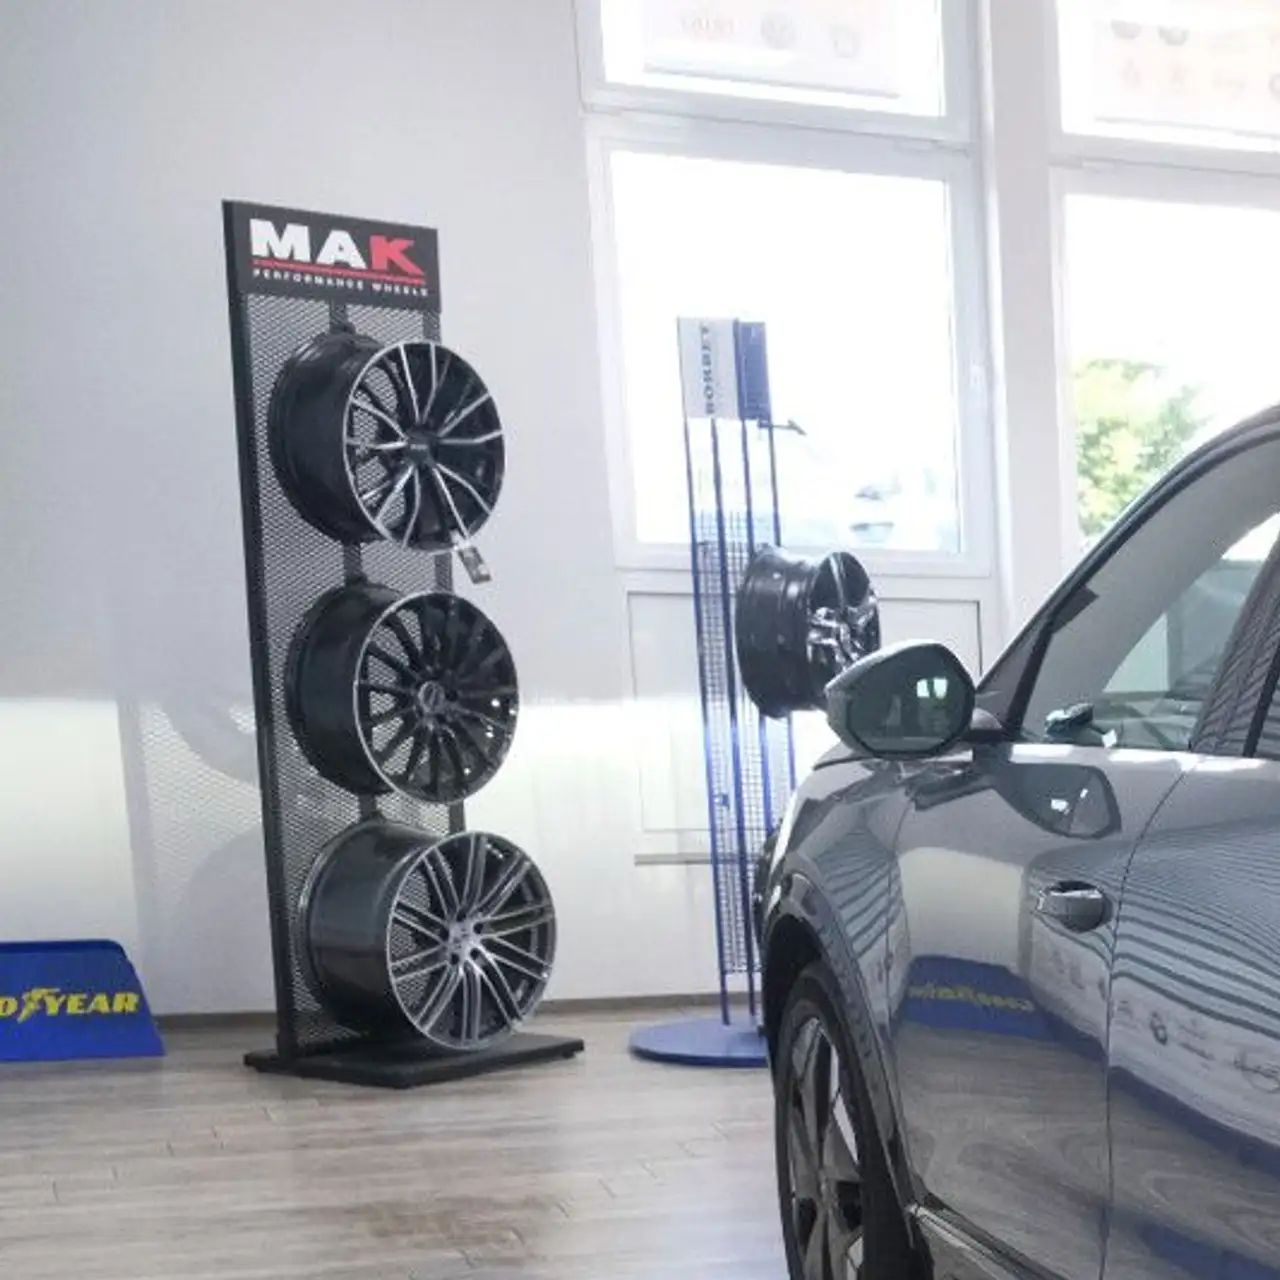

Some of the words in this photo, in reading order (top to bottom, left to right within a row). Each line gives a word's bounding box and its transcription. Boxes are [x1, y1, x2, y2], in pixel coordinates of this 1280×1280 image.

[249, 217, 425, 277] MAK
[253, 267, 364, 292] PERFORMANCE
[371, 282, 429, 298] WHEELS
